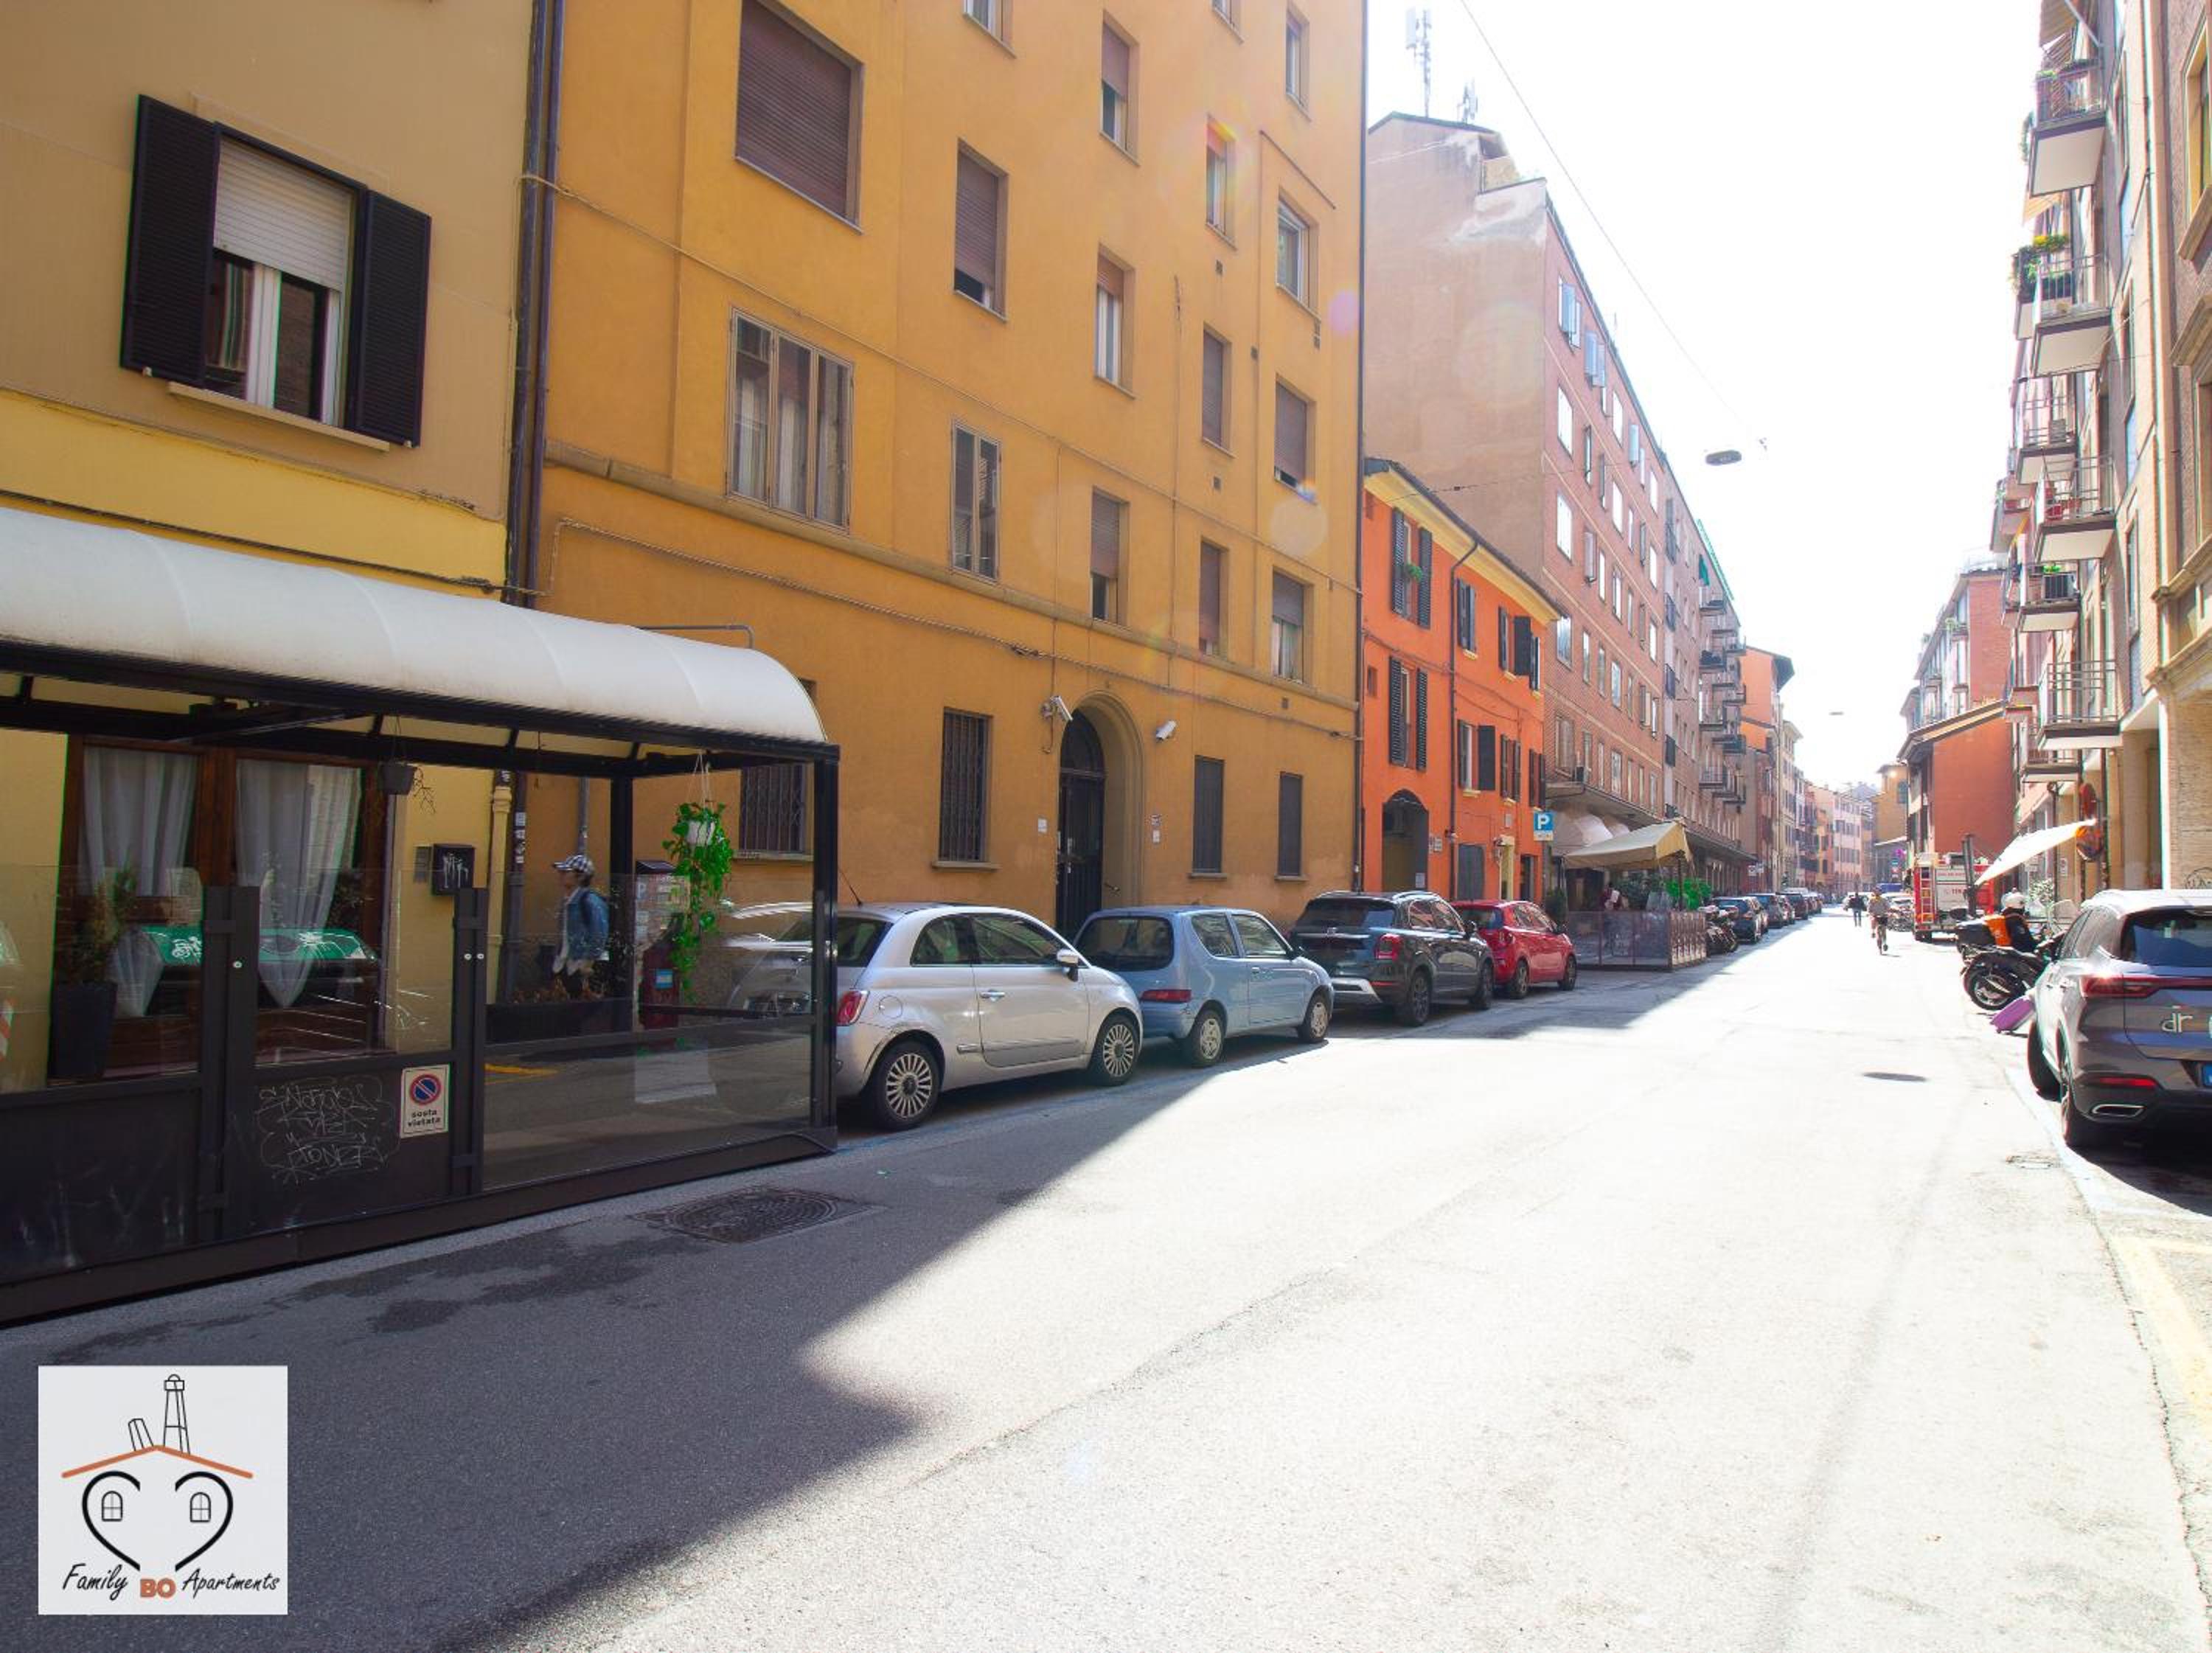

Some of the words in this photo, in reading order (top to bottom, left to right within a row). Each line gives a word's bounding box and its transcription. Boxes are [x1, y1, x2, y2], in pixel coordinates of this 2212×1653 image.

[1537, 813, 1550, 829] P
[411, 1108, 437, 1118] sosta
[407, 1117, 441, 1127] vietata
